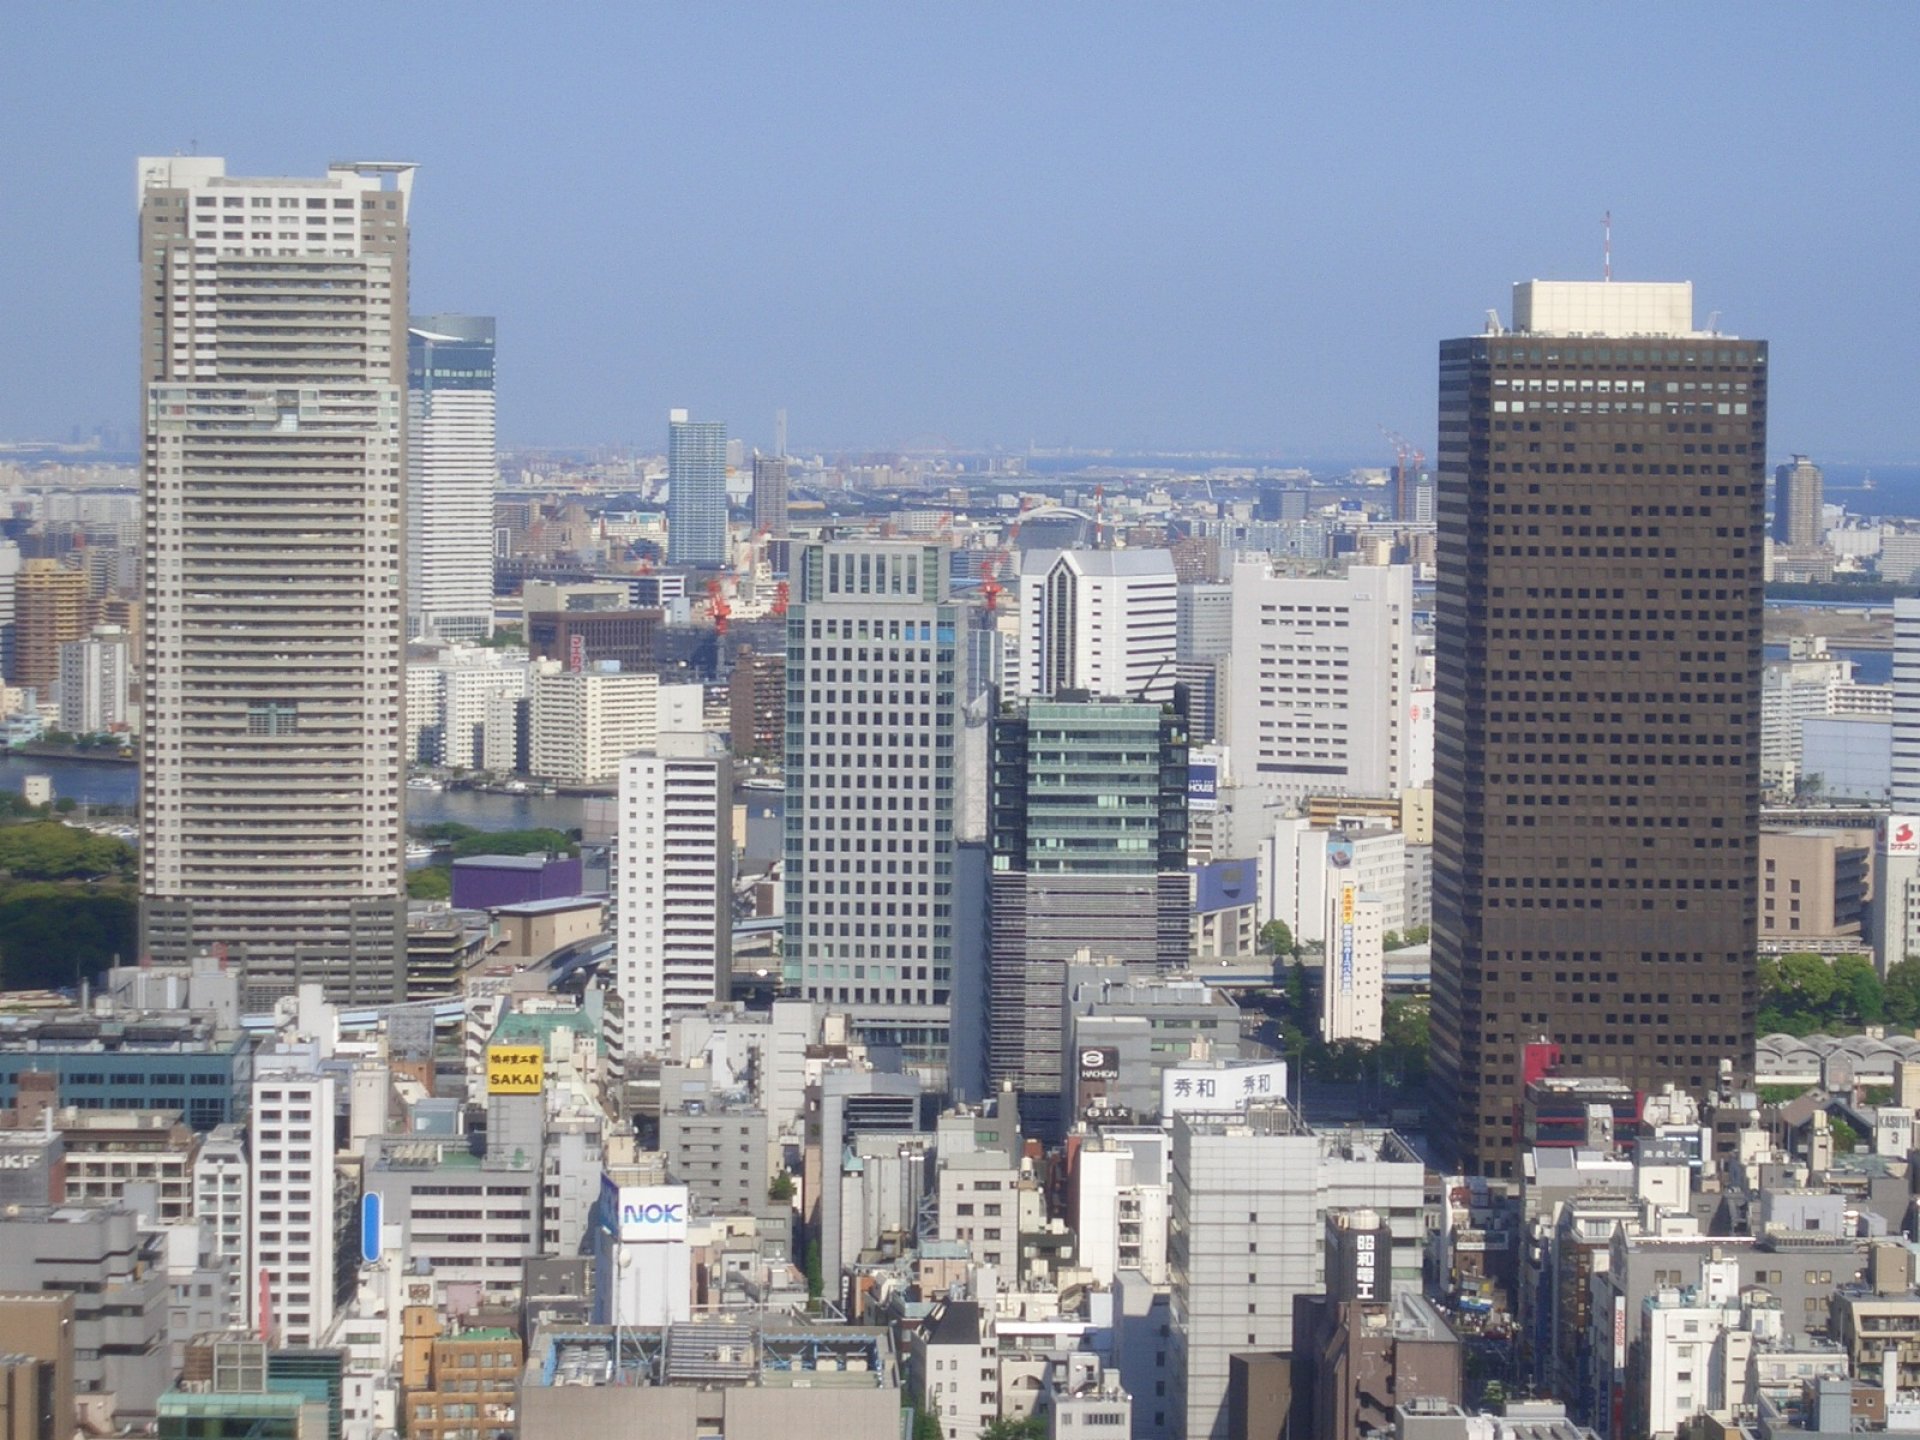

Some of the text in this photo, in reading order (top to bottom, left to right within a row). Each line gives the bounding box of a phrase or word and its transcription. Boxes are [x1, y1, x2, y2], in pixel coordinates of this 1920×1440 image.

[491, 1074, 539, 1085] SAKAI
[1174, 1078, 1216, 1098] 秀和
[1243, 1074, 1271, 1095] 秀和
[1891, 1132, 1899, 1144] 3
[0, 1154, 40, 1169] KF
[624, 1204, 683, 1223] NOK
[1357, 1235, 1375, 1299] 昭和電工
